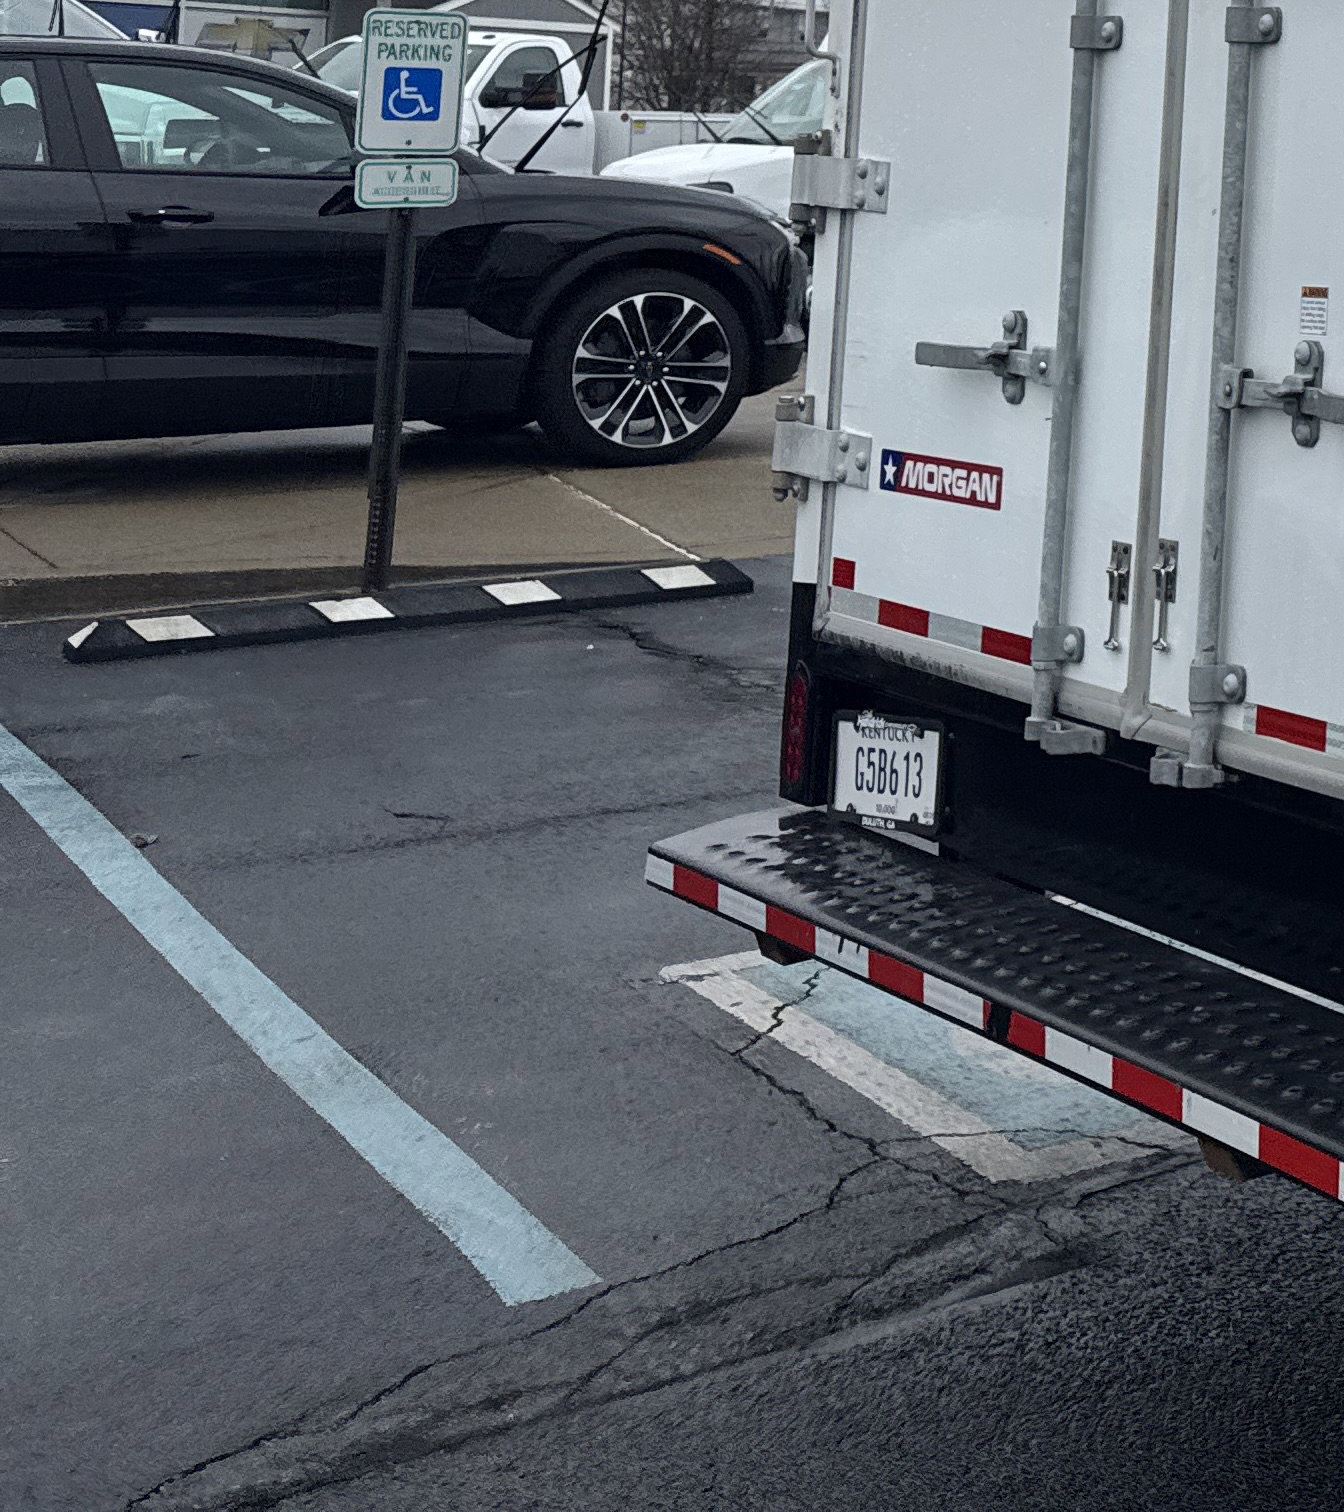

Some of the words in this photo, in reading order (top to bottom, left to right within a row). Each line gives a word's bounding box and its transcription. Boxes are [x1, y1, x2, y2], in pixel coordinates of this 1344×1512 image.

[371, 19, 462, 39] RESERVED
[377, 43, 453, 62] PARKING
[387, 170, 431, 183] VAN
[901, 460, 998, 503] MORGAN
[855, 746, 923, 798] G5B613
